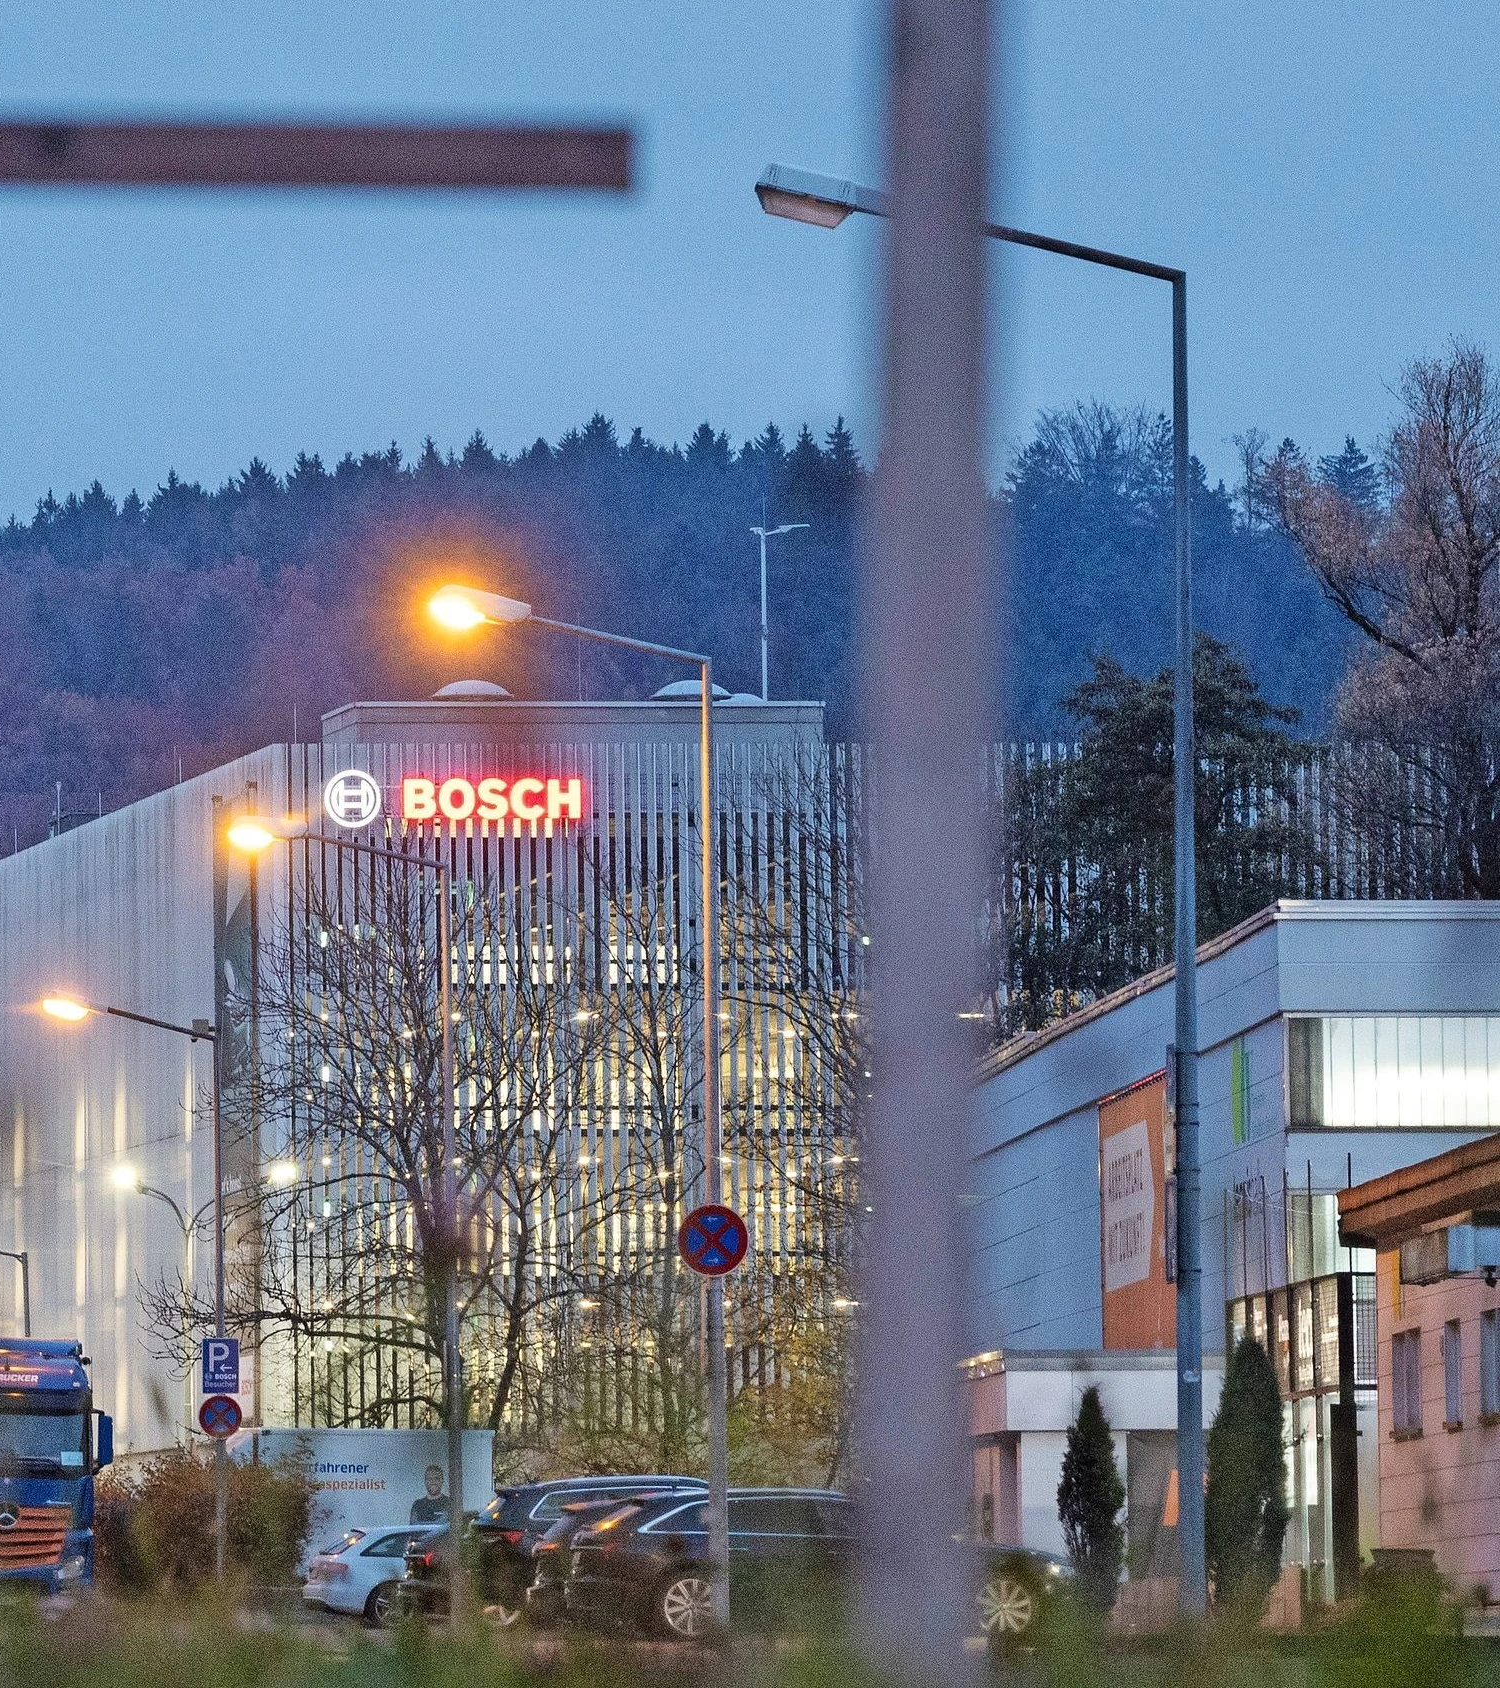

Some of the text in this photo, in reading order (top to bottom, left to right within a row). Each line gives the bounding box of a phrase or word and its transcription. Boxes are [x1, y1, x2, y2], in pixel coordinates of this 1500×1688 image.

[403, 778, 581, 819] BOSCH
[209, 1342, 230, 1372] P
[204, 1380, 236, 1388] Besucher
